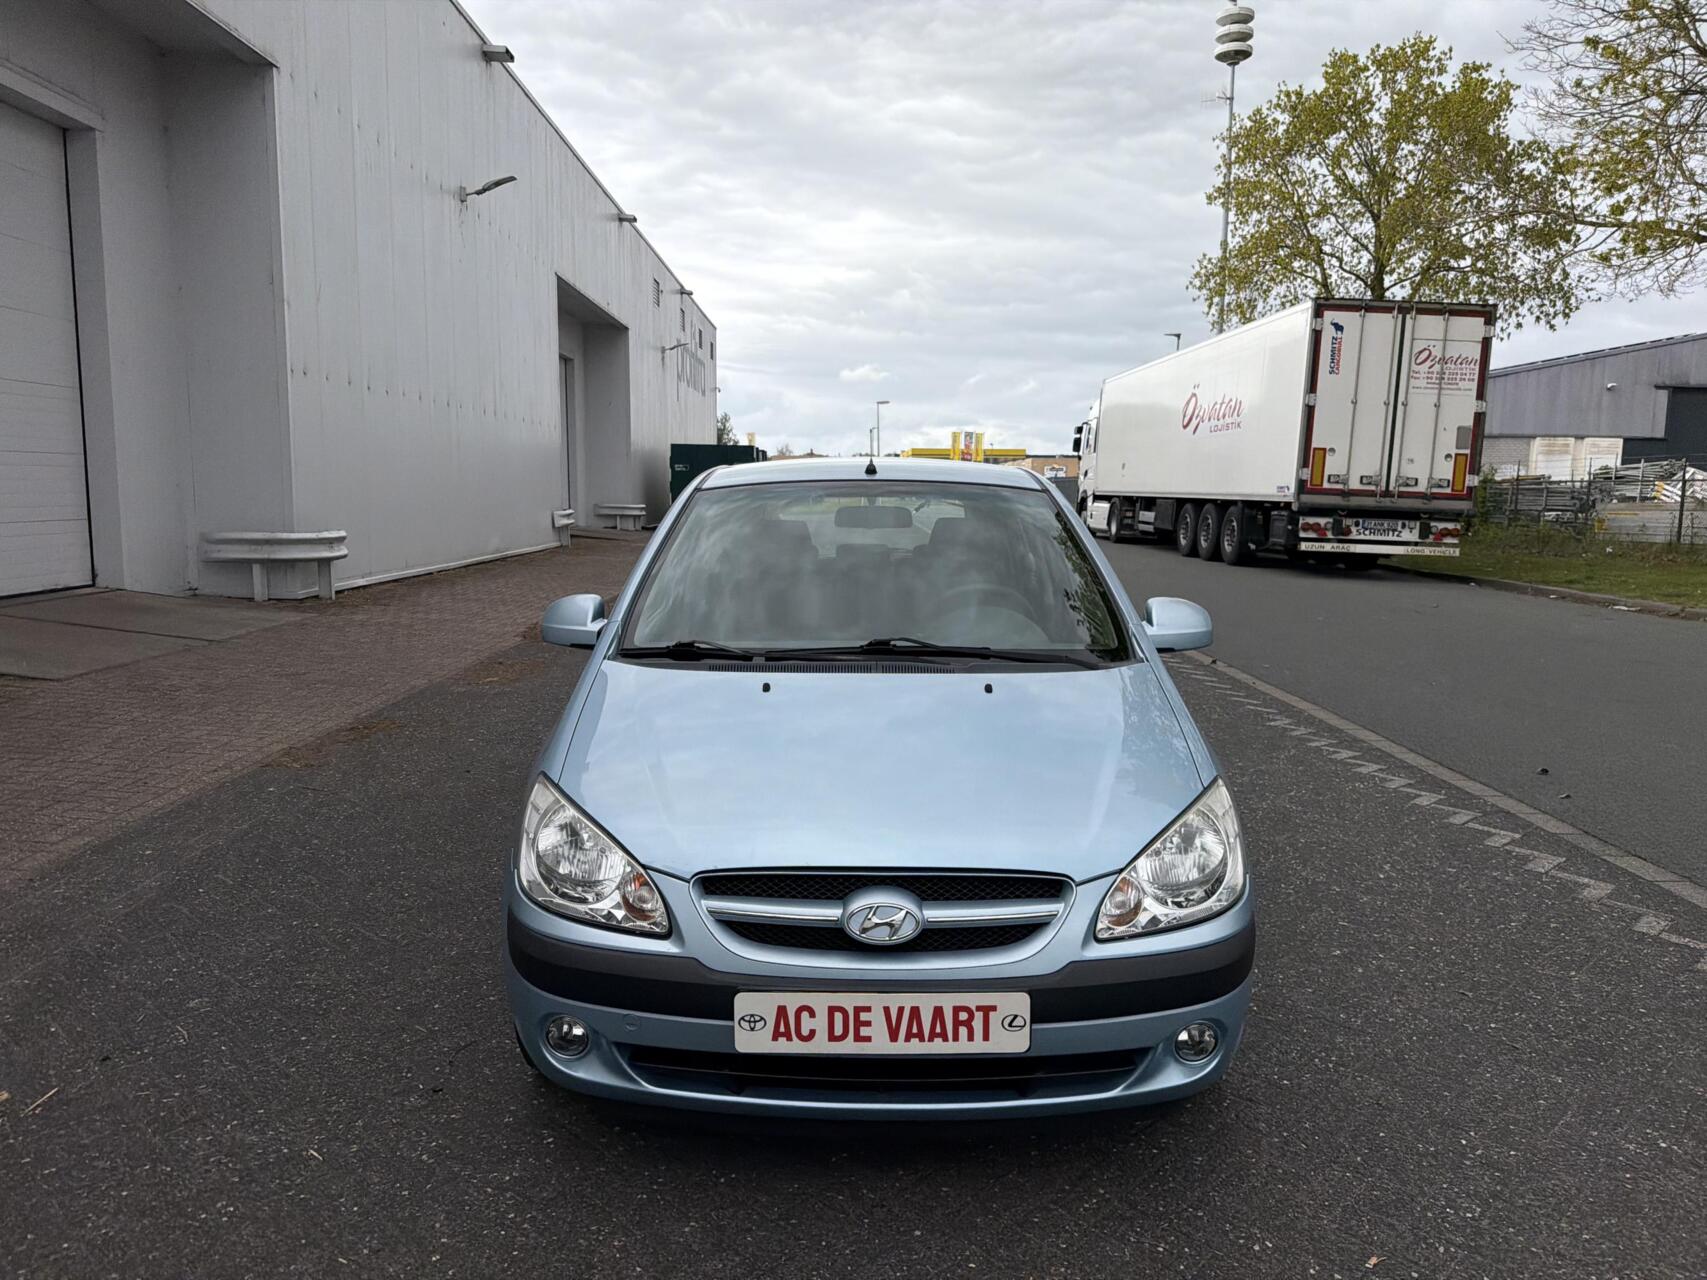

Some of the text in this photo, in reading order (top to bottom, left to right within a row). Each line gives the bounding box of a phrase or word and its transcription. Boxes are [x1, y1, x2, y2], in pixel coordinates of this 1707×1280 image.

[1329, 336, 1337, 375] SCHMITZ
[1356, 528, 1402, 537] SCHMITZ
[771, 1004, 998, 1042] AC DE VAART
